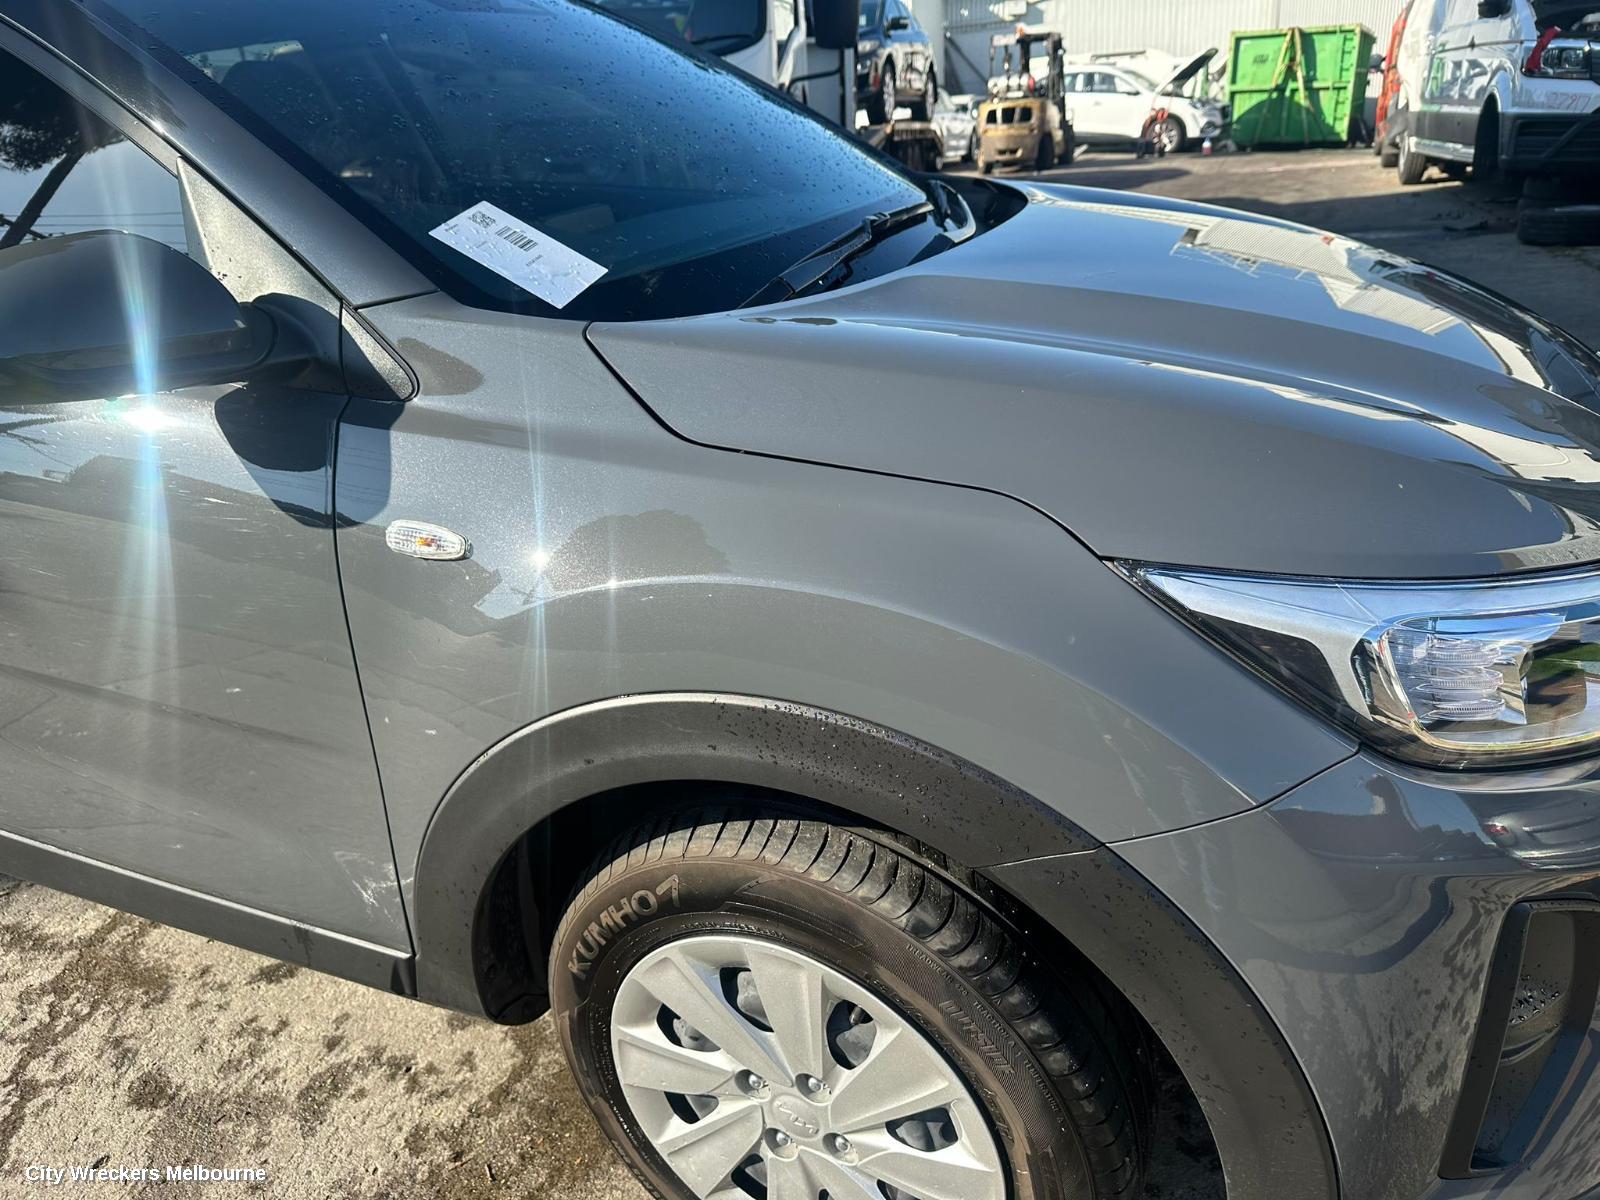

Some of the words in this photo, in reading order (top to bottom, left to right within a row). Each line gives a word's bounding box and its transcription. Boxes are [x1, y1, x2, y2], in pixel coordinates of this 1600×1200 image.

[567, 889, 658, 981] KUMHO
[938, 1000, 1015, 1074] OUTSIDE
[973, 1000, 1010, 1038] TRACTION
